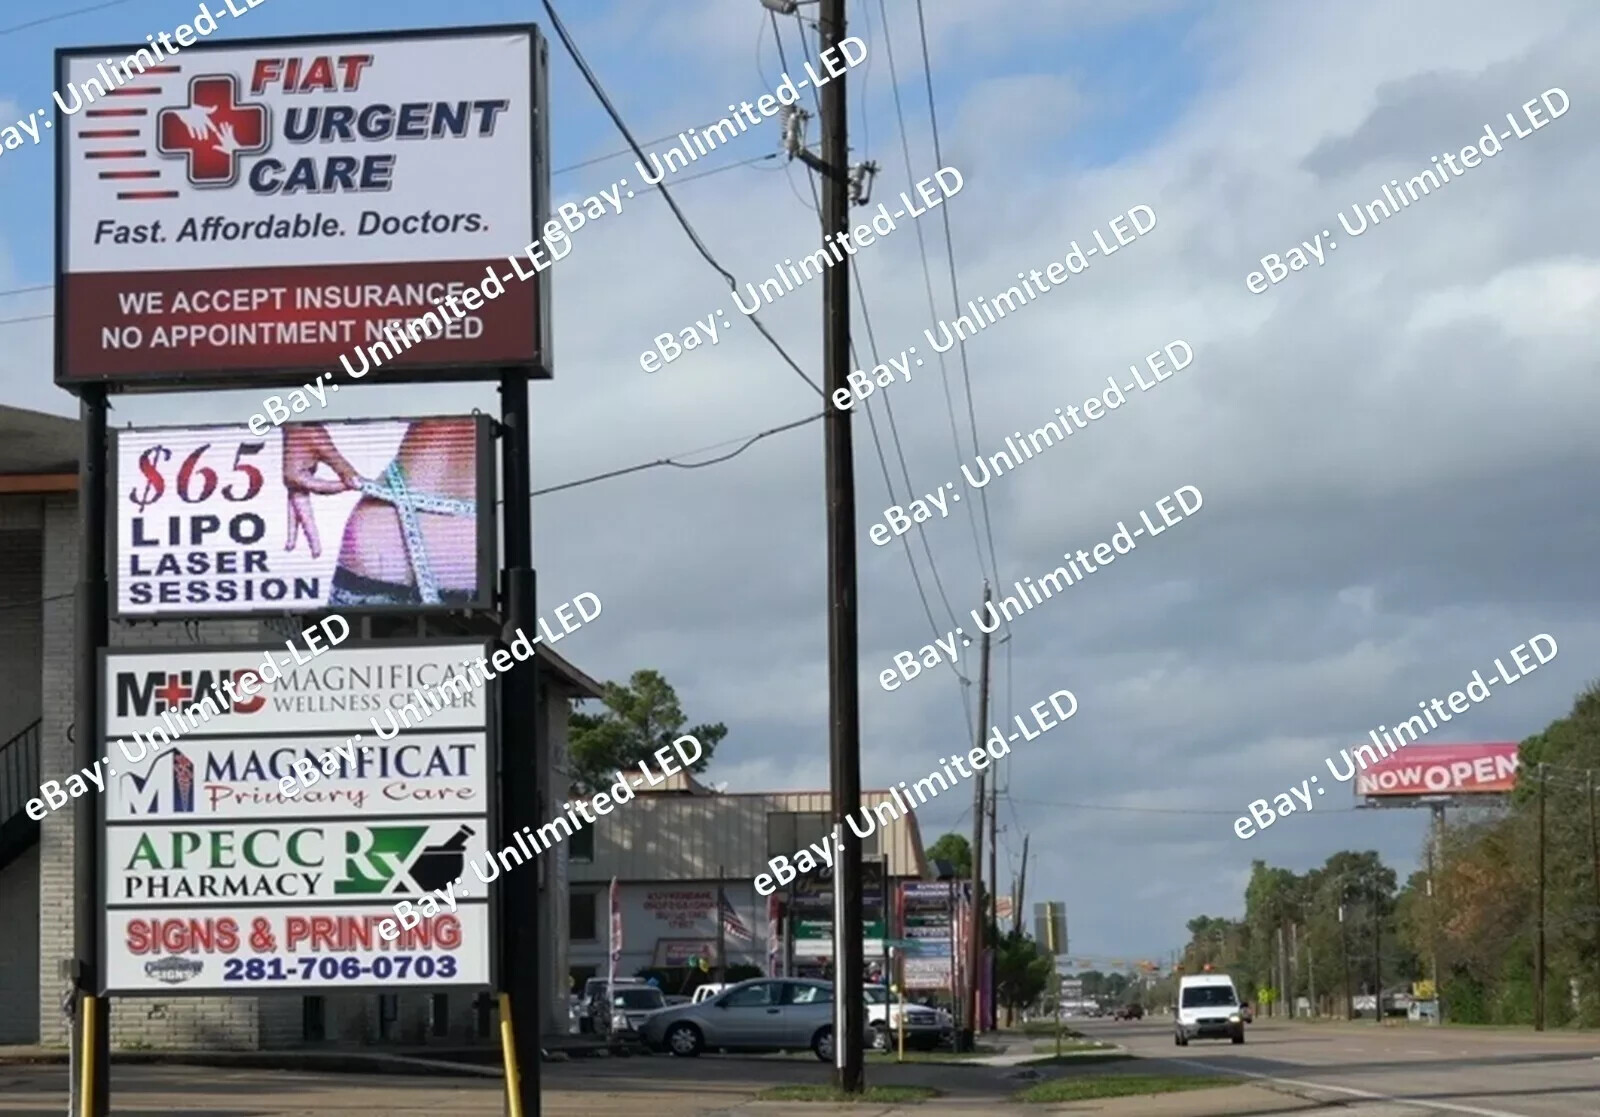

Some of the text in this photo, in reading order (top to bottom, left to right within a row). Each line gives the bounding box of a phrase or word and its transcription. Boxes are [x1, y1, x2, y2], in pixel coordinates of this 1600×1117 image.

[249, 54, 373, 96] FIAT
[282, 99, 509, 142] URGENT
[247, 154, 396, 195] CARE
[95, 209, 489, 244] Fast. Affordable. Doctors.
[118, 281, 465, 315] WE ACCEPT INSURANCE
[101, 326, 142, 349] NO
[150, 320, 355, 348] APPOINTMENT
[130, 441, 265, 511] $65
[131, 512, 266, 547] LIPO
[130, 549, 269, 576] LASER
[130, 577, 320, 604] SESSION
[272, 662, 476, 692] MAGNIFICAT
[272, 693, 382, 713] WELLNESS
[203, 743, 476, 783] MAGNIFICAT
[1361, 752, 1519, 793] NOW OPEN
[383, 781, 476, 802] Care
[126, 827, 325, 870] APECC
[125, 873, 323, 898] PHARMACY
[127, 914, 463, 955] SIGNS & PRINTING
[223, 955, 459, 981] 281-706-0703
